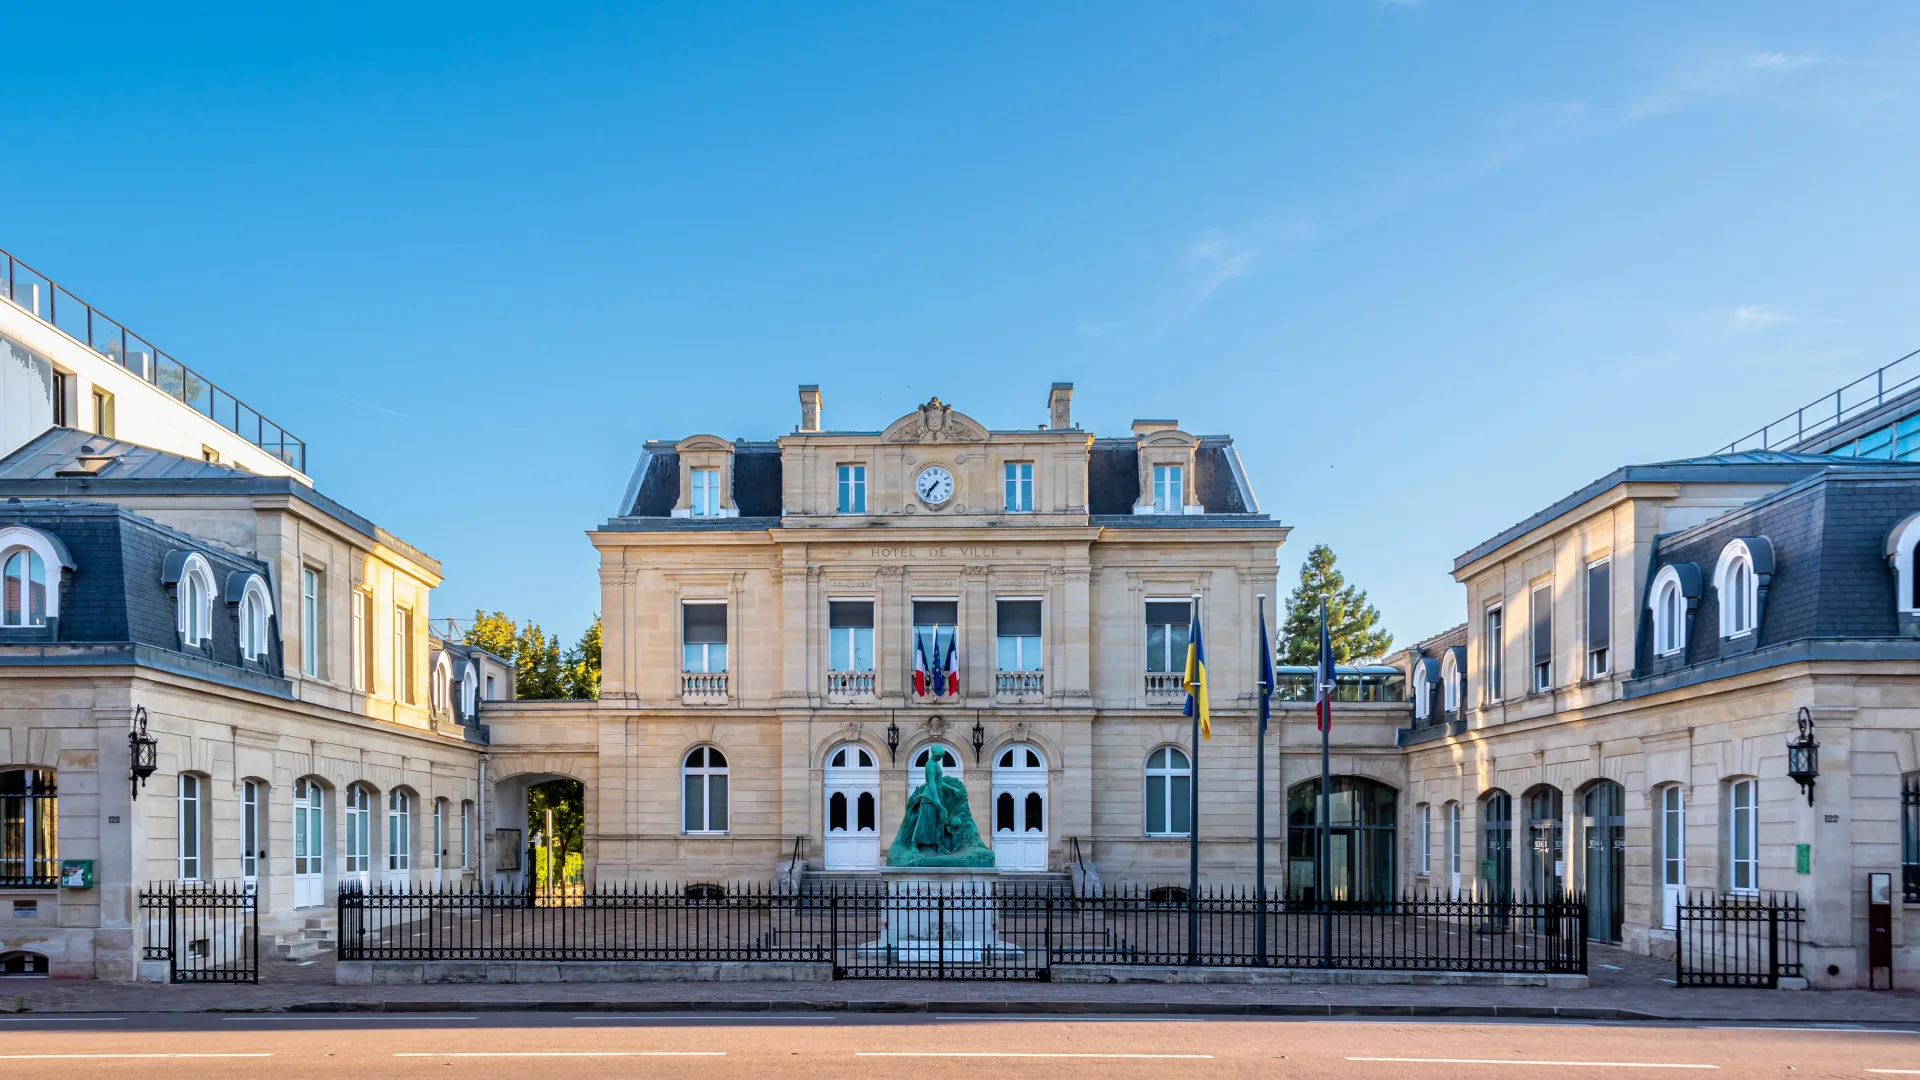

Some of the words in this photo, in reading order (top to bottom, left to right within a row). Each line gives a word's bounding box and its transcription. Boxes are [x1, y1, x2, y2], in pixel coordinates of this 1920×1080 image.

[871, 547, 916, 558] HOTEL
[929, 547, 947, 558] DE
[960, 547, 999, 558] VILLE
[108, 815, 121, 823] 122
[1824, 814, 1839, 823] 122
